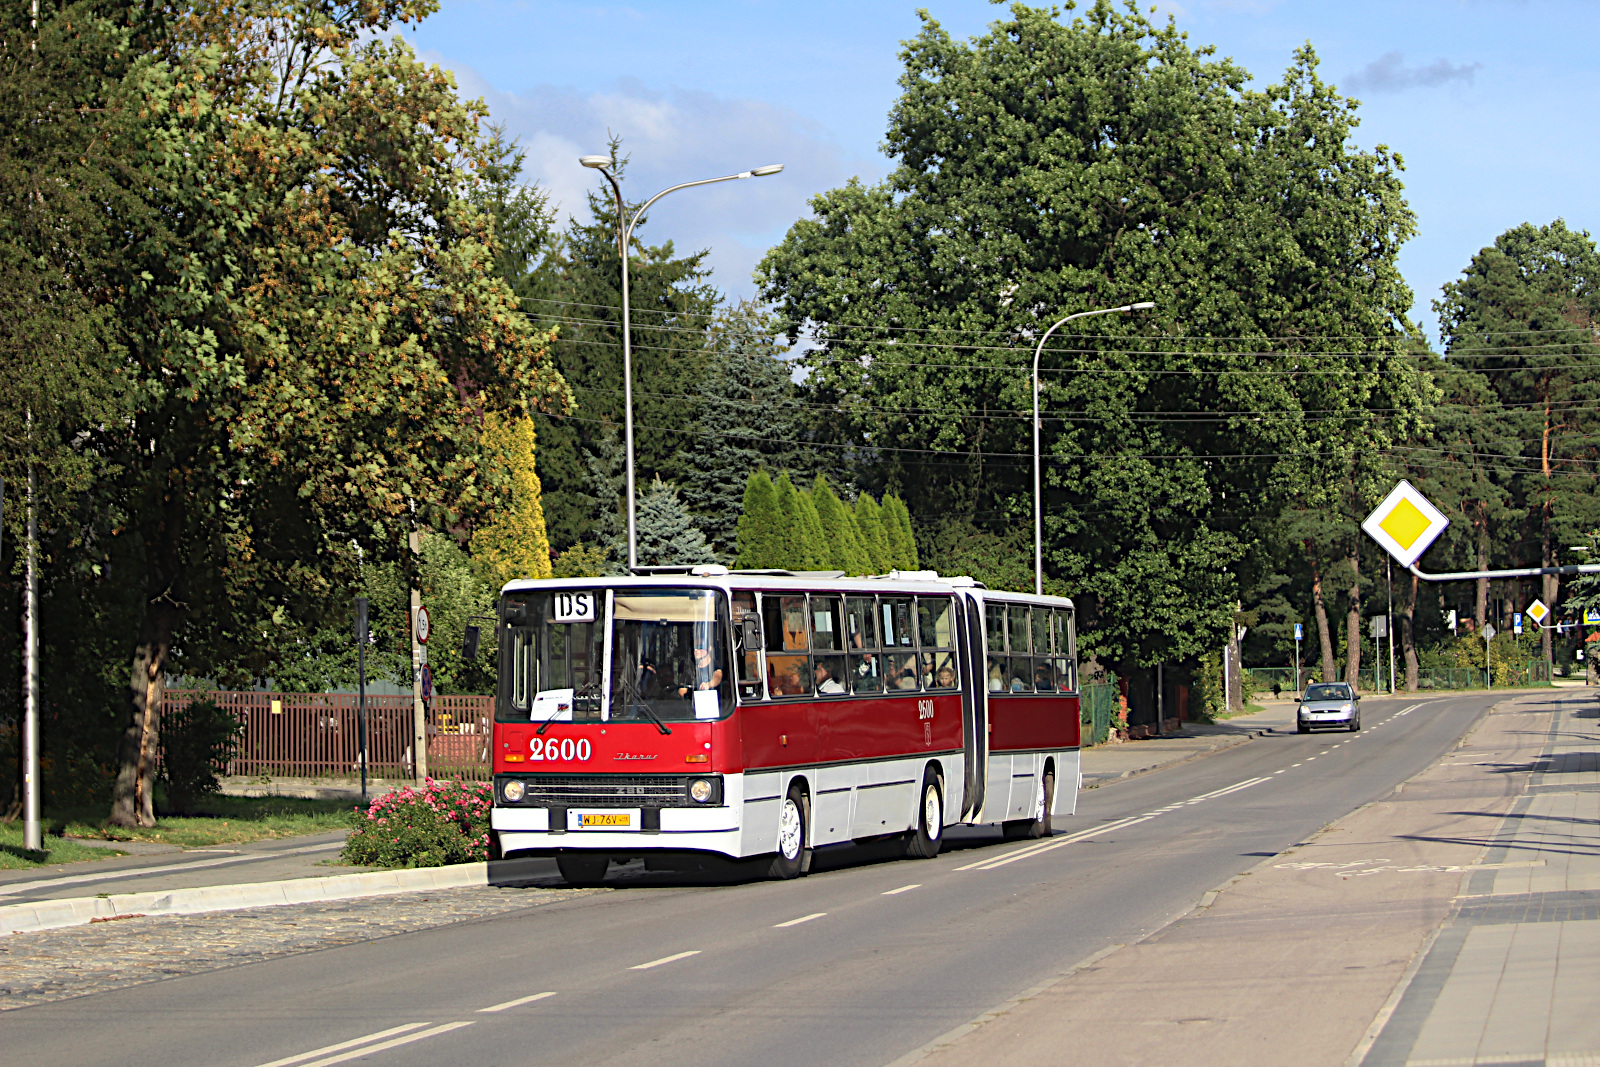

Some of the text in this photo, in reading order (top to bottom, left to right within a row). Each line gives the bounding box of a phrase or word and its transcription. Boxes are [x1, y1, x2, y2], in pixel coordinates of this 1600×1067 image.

[560, 593, 588, 616] DS
[1515, 614, 1521, 625] P
[918, 699, 935, 719] 2600
[529, 738, 592, 761] 2600
[613, 752, 658, 760] Ikarus
[600, 815, 617, 825] 76V
